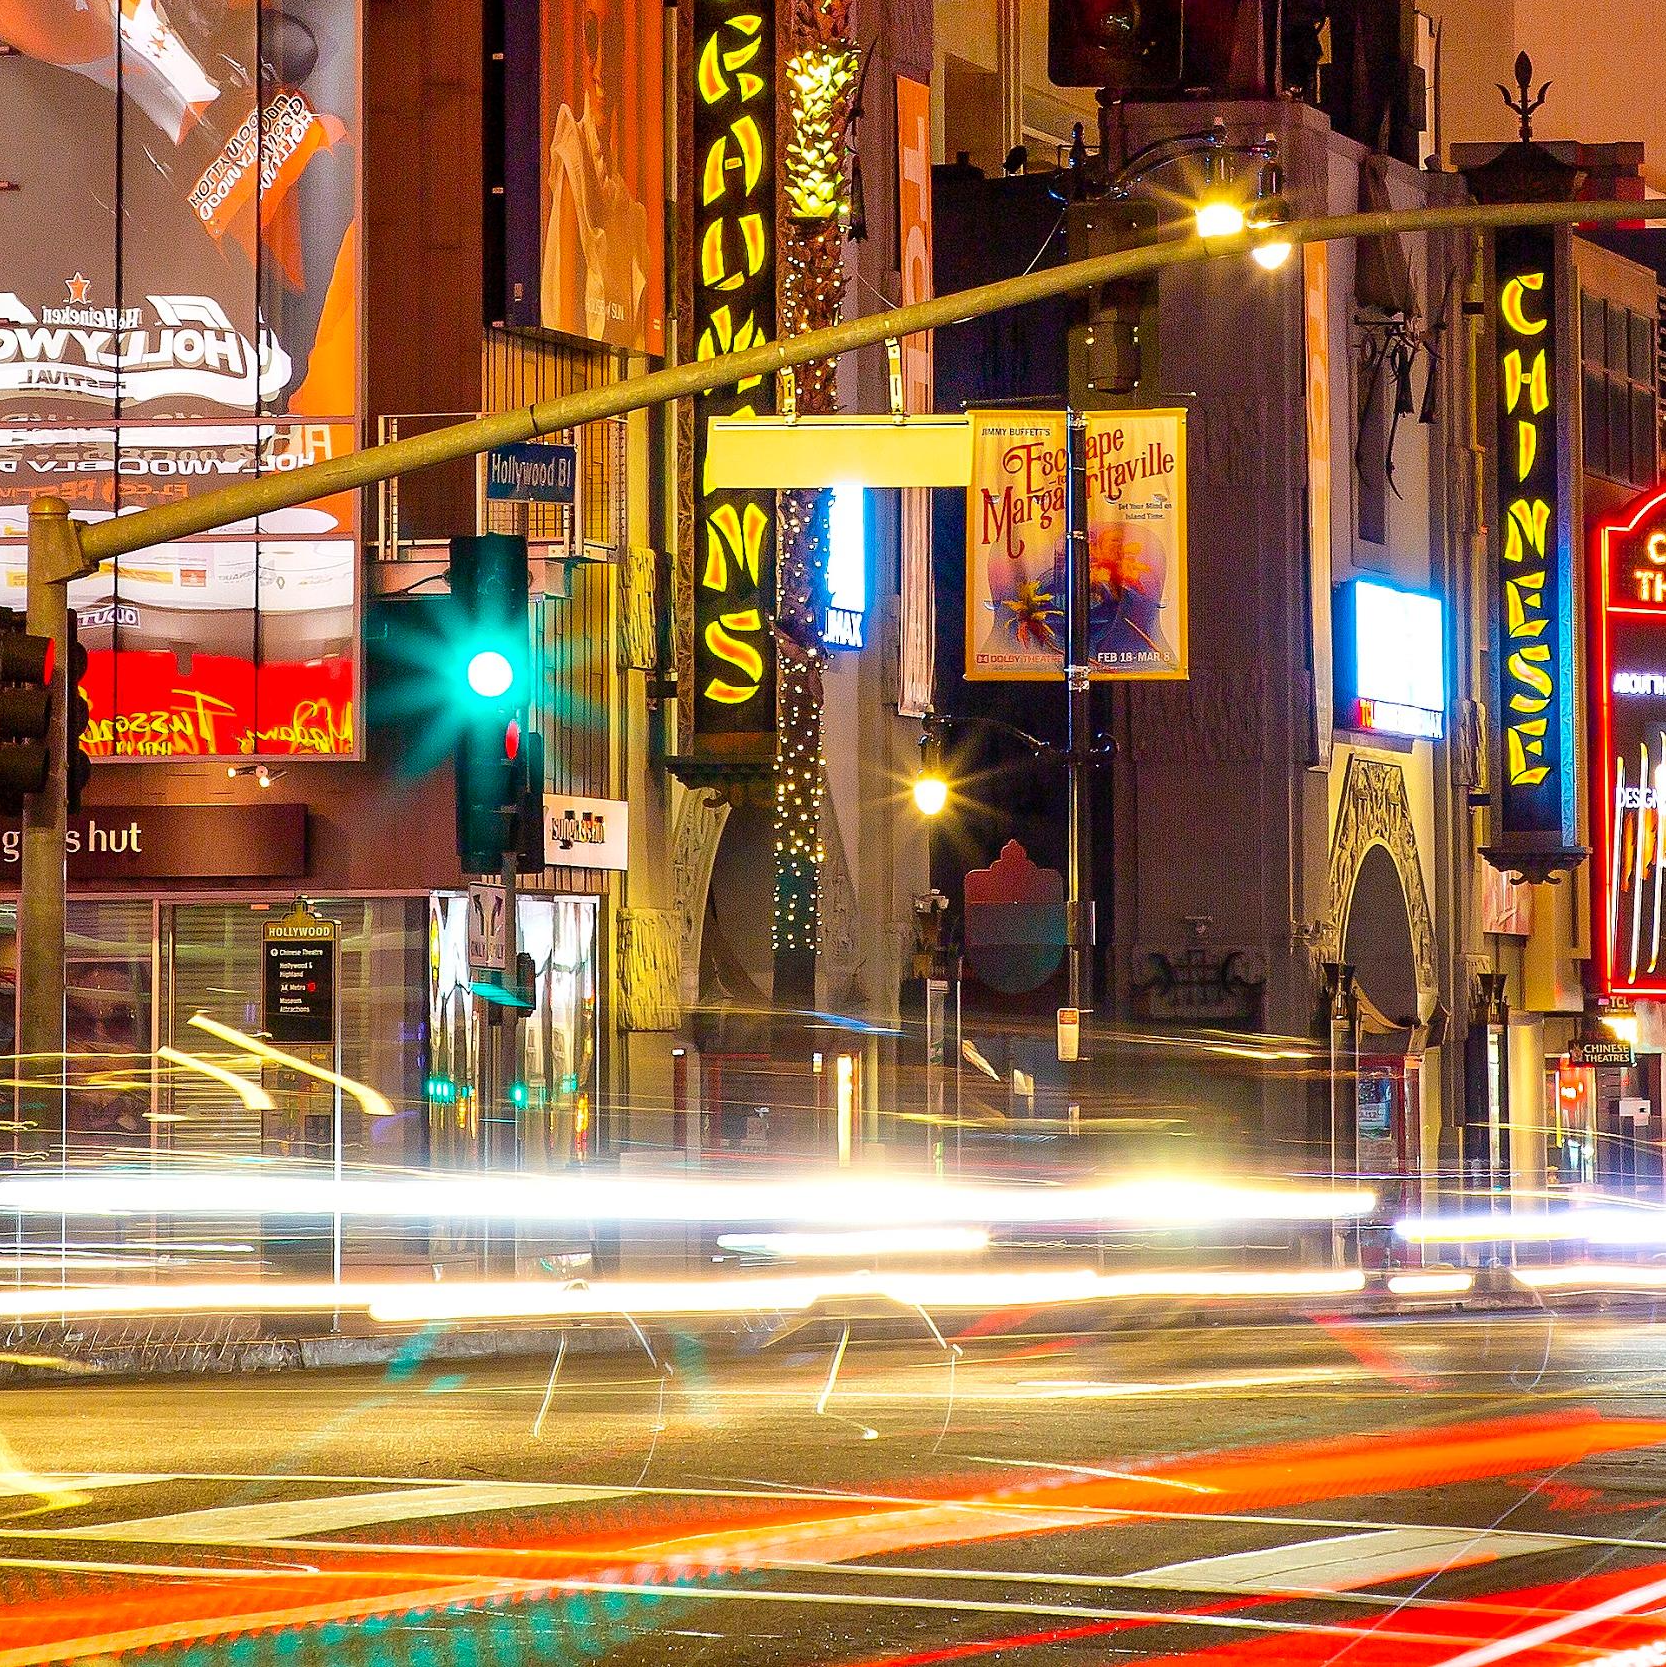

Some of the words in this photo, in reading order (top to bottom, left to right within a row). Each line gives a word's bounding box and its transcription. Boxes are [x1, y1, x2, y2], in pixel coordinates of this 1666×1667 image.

[981, 428, 1007, 436] JIMMY
[1009, 428, 1051, 437] BUFFETT'S
[492, 453, 555, 492] Hollywood
[558, 457, 571, 488] Bl
[1500, 271, 1554, 788] CHINESE
[1097, 651, 1119, 664] FEB
[88, 820, 142, 853] hut
[268, 926, 330, 937] HOLLYWOOD
[1609, 995, 1629, 1008] TCL
[1583, 1044, 1630, 1054] CHINESE
[1584, 1053, 1630, 1063] THEATRES
